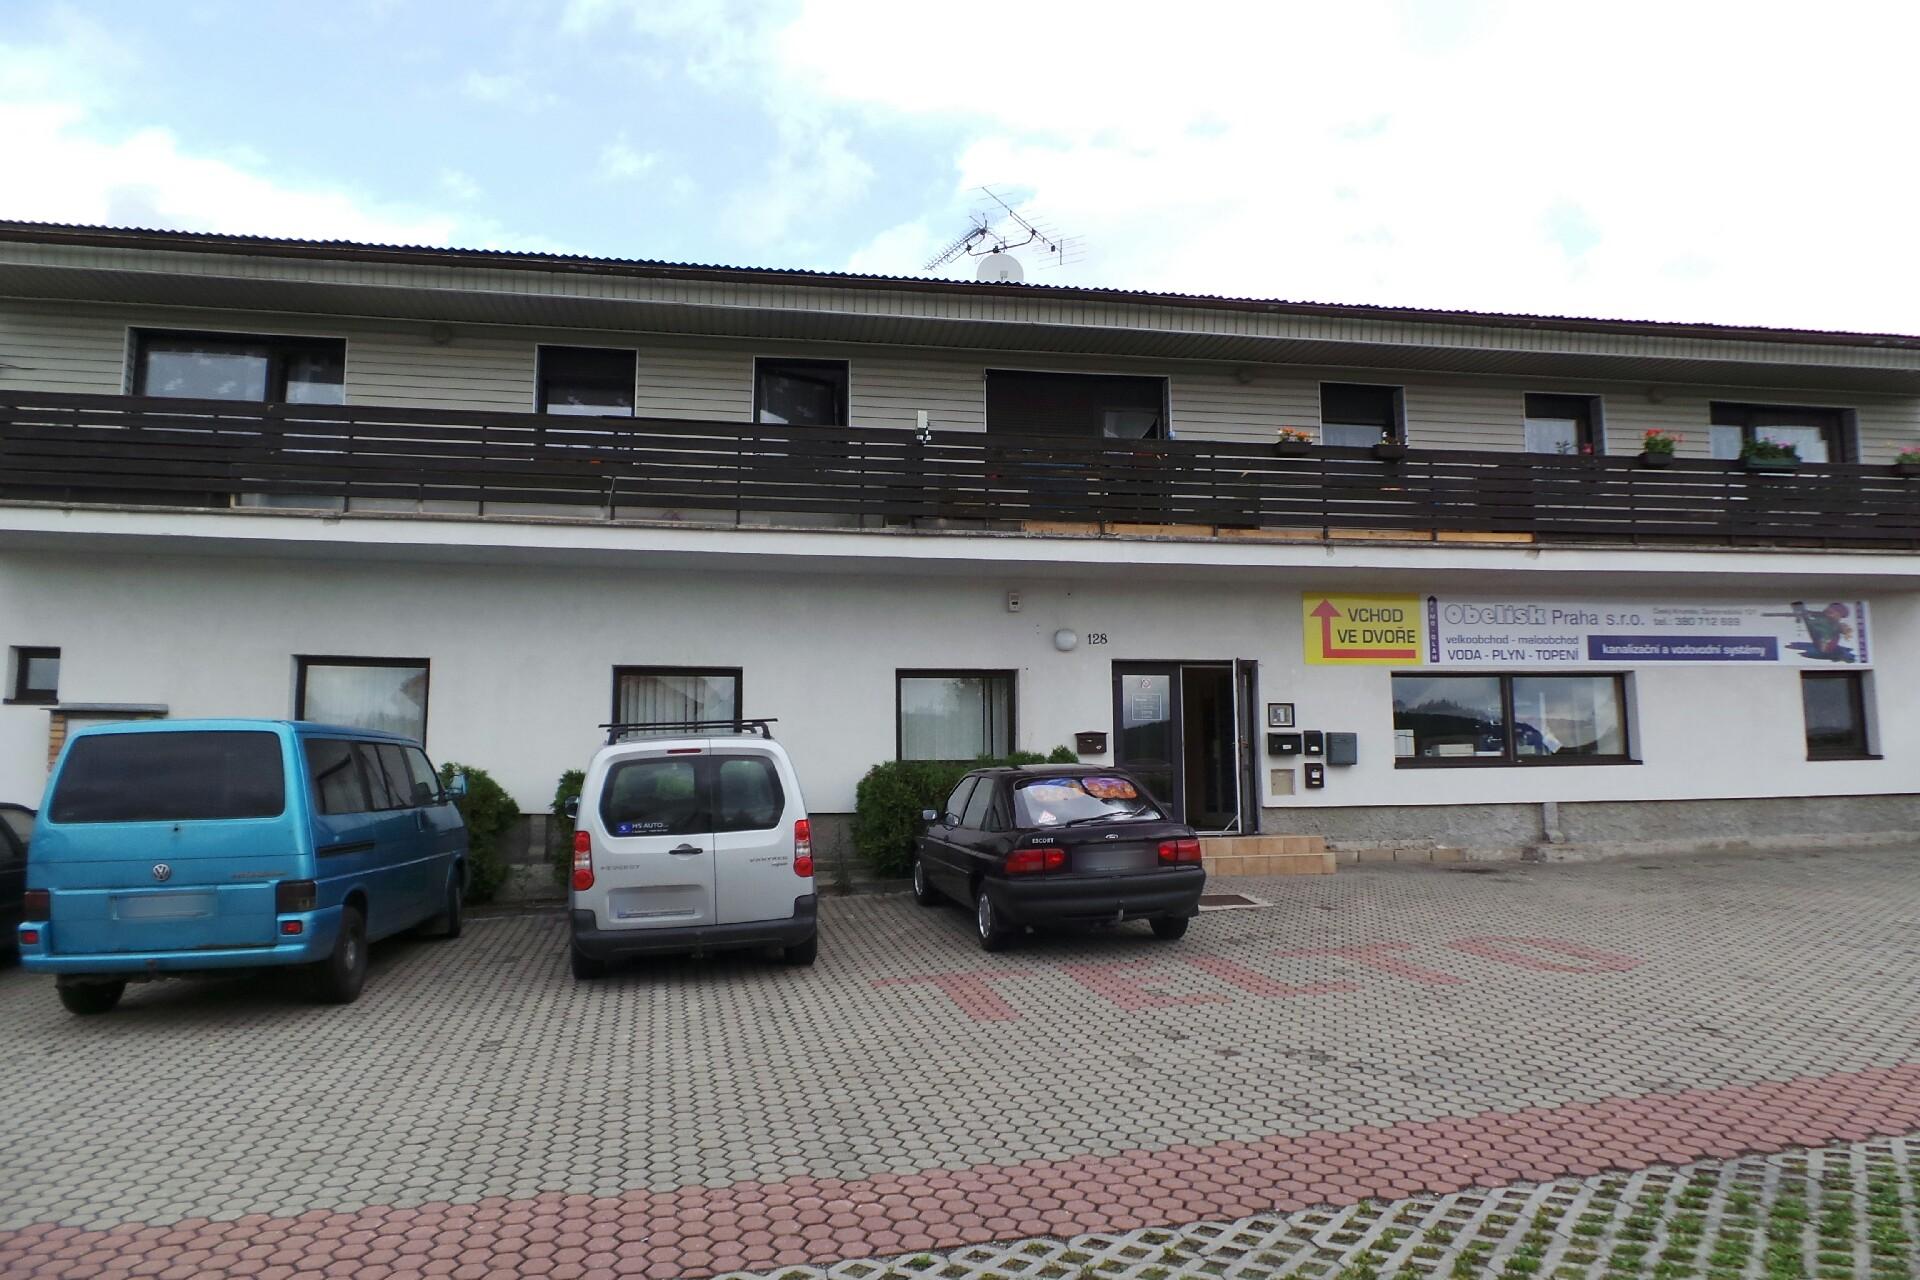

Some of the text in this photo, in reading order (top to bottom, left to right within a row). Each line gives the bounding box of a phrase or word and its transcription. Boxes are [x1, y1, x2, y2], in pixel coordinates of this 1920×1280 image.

[1347, 608, 1404, 623] VCHOD
[1444, 603, 1645, 626] Obelisk Praha s.r.o.
[1087, 633, 1108, 645] 128
[1337, 626, 1416, 643] VE DVOŘE
[1446, 635, 1509, 644] velkoobchod
[1447, 650, 1482, 660] VODA
[1492, 650, 1525, 660] PLYN
[1535, 648, 1579, 660] TOPENÍ
